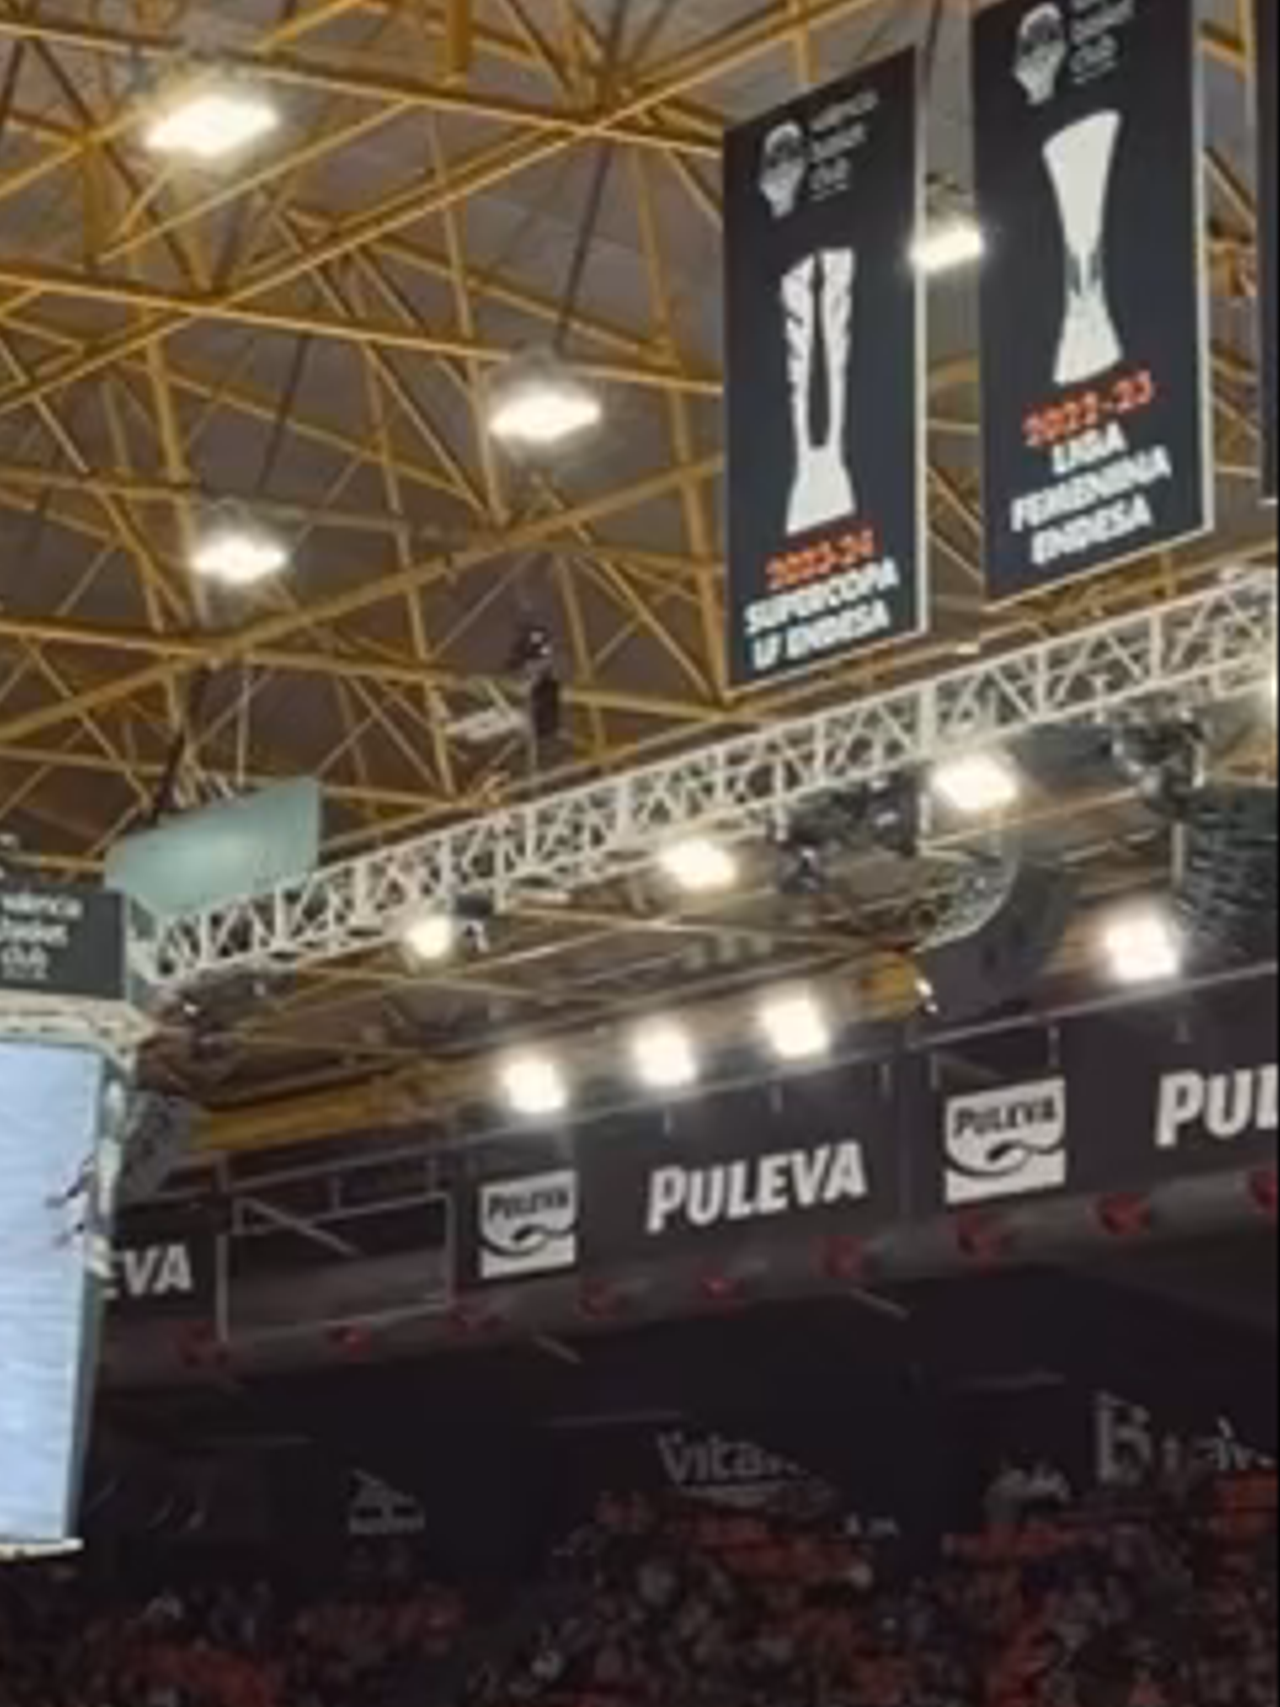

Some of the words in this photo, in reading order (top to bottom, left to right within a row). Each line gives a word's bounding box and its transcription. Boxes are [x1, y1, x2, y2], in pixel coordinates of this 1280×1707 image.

[1030, 493, 1154, 565] ENDESA
[744, 556, 901, 636] SUPERCOPA
[950, 1097, 1059, 1142] PULEVA
[486, 1182, 574, 1221] PULEVA
[646, 1140, 868, 1234] PULEVA
